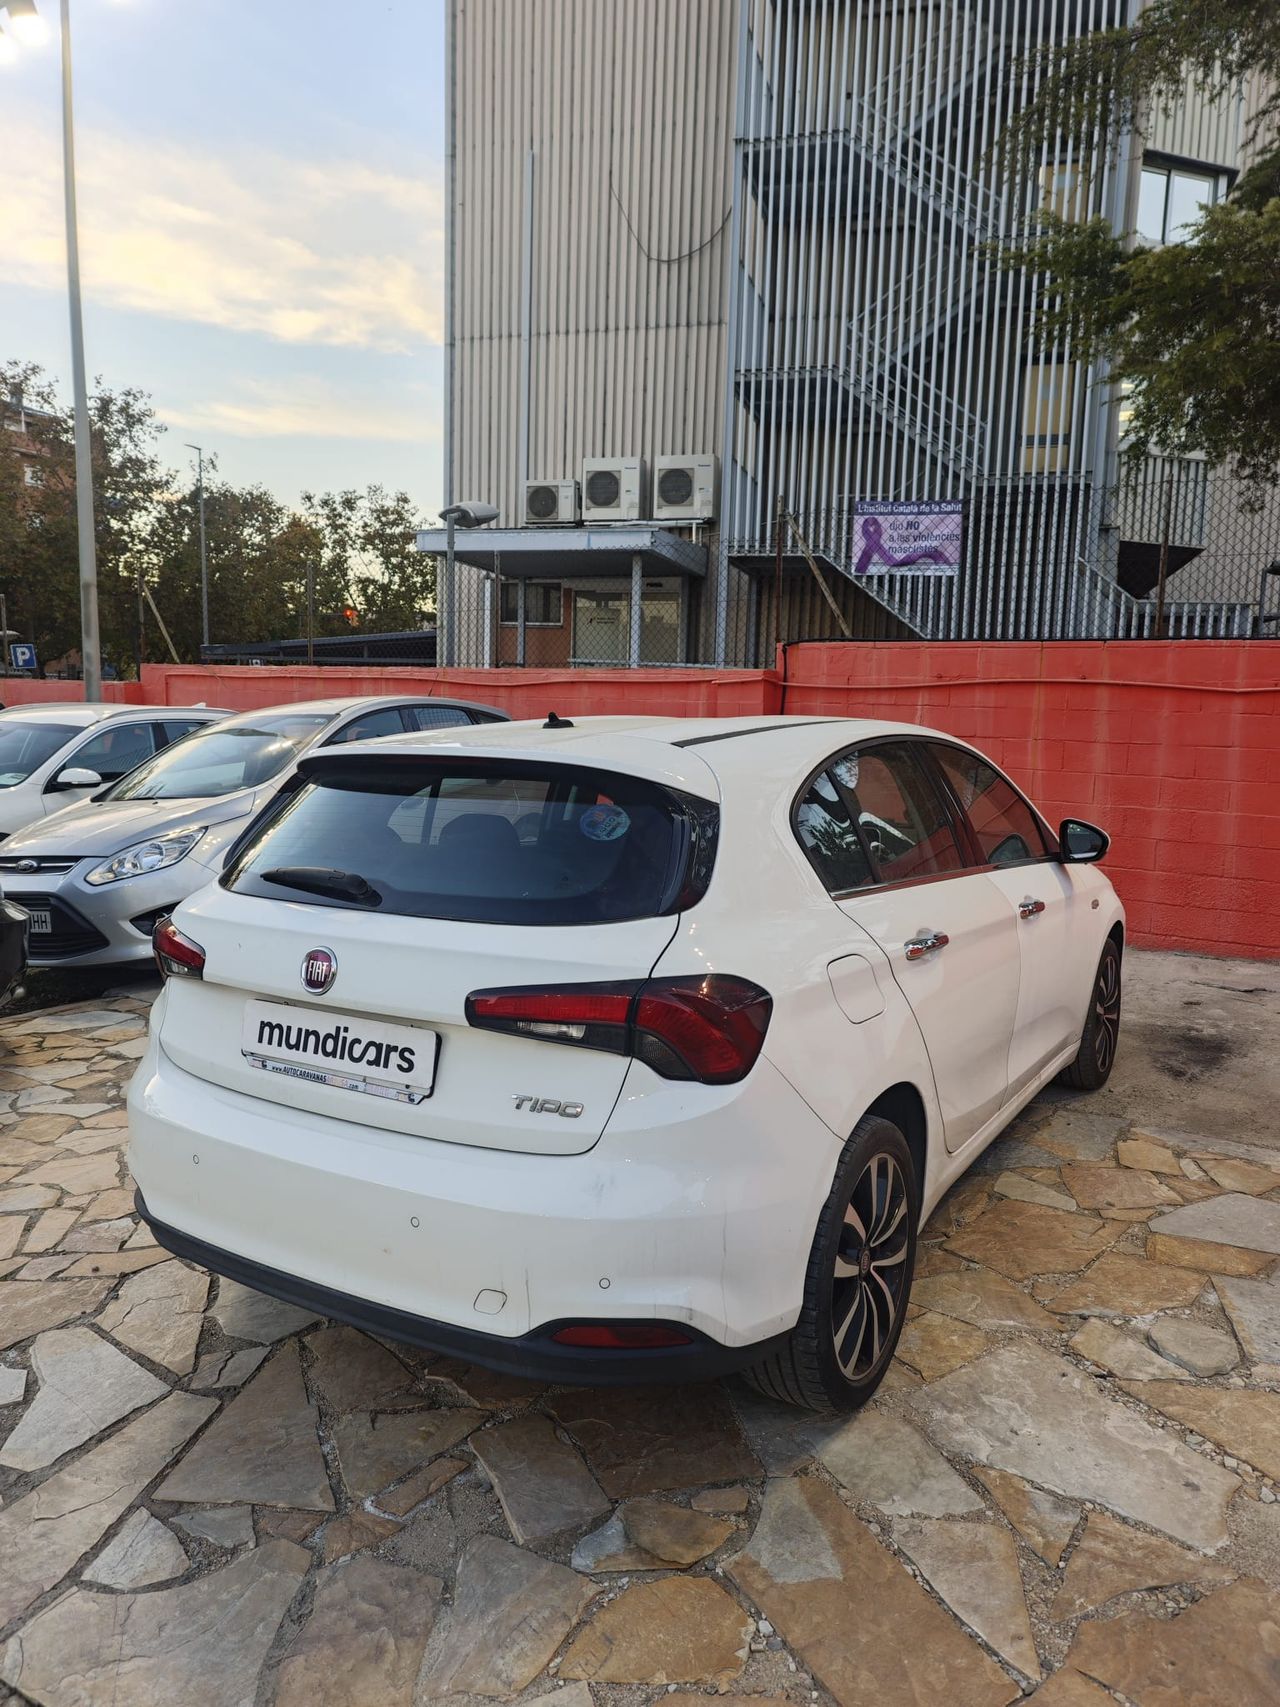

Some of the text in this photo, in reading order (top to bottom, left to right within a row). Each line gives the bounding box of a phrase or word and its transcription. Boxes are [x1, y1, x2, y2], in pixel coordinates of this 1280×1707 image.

[941, 503, 963, 512] Salut
[905, 520, 920, 530] NO
[16, 647, 30, 666] P
[307, 960, 329, 982] FIAT
[257, 1020, 416, 1073] mundicars
[511, 1094, 584, 1118] TIPO
